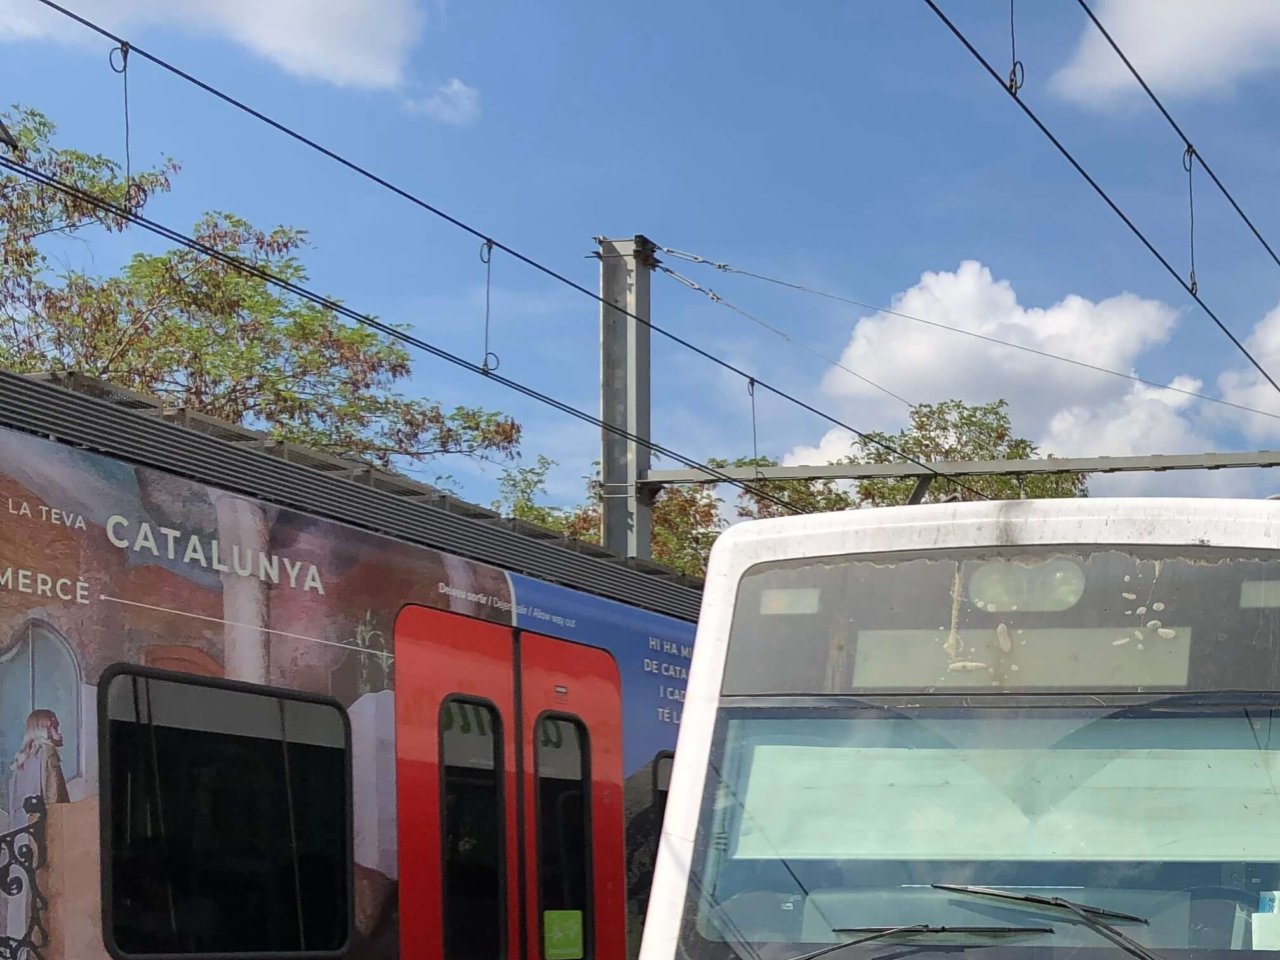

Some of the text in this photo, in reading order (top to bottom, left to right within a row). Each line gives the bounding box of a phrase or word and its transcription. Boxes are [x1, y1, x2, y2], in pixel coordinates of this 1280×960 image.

[8, 498, 325, 595] LA TEVA CATALUNYA
[0, 567, 90, 605] MERCÈ
[649, 636, 660, 650] HI
[663, 641, 678, 656] HA
[644, 658, 687, 680] DE CATA
[657, 706, 671, 722] TÉ
